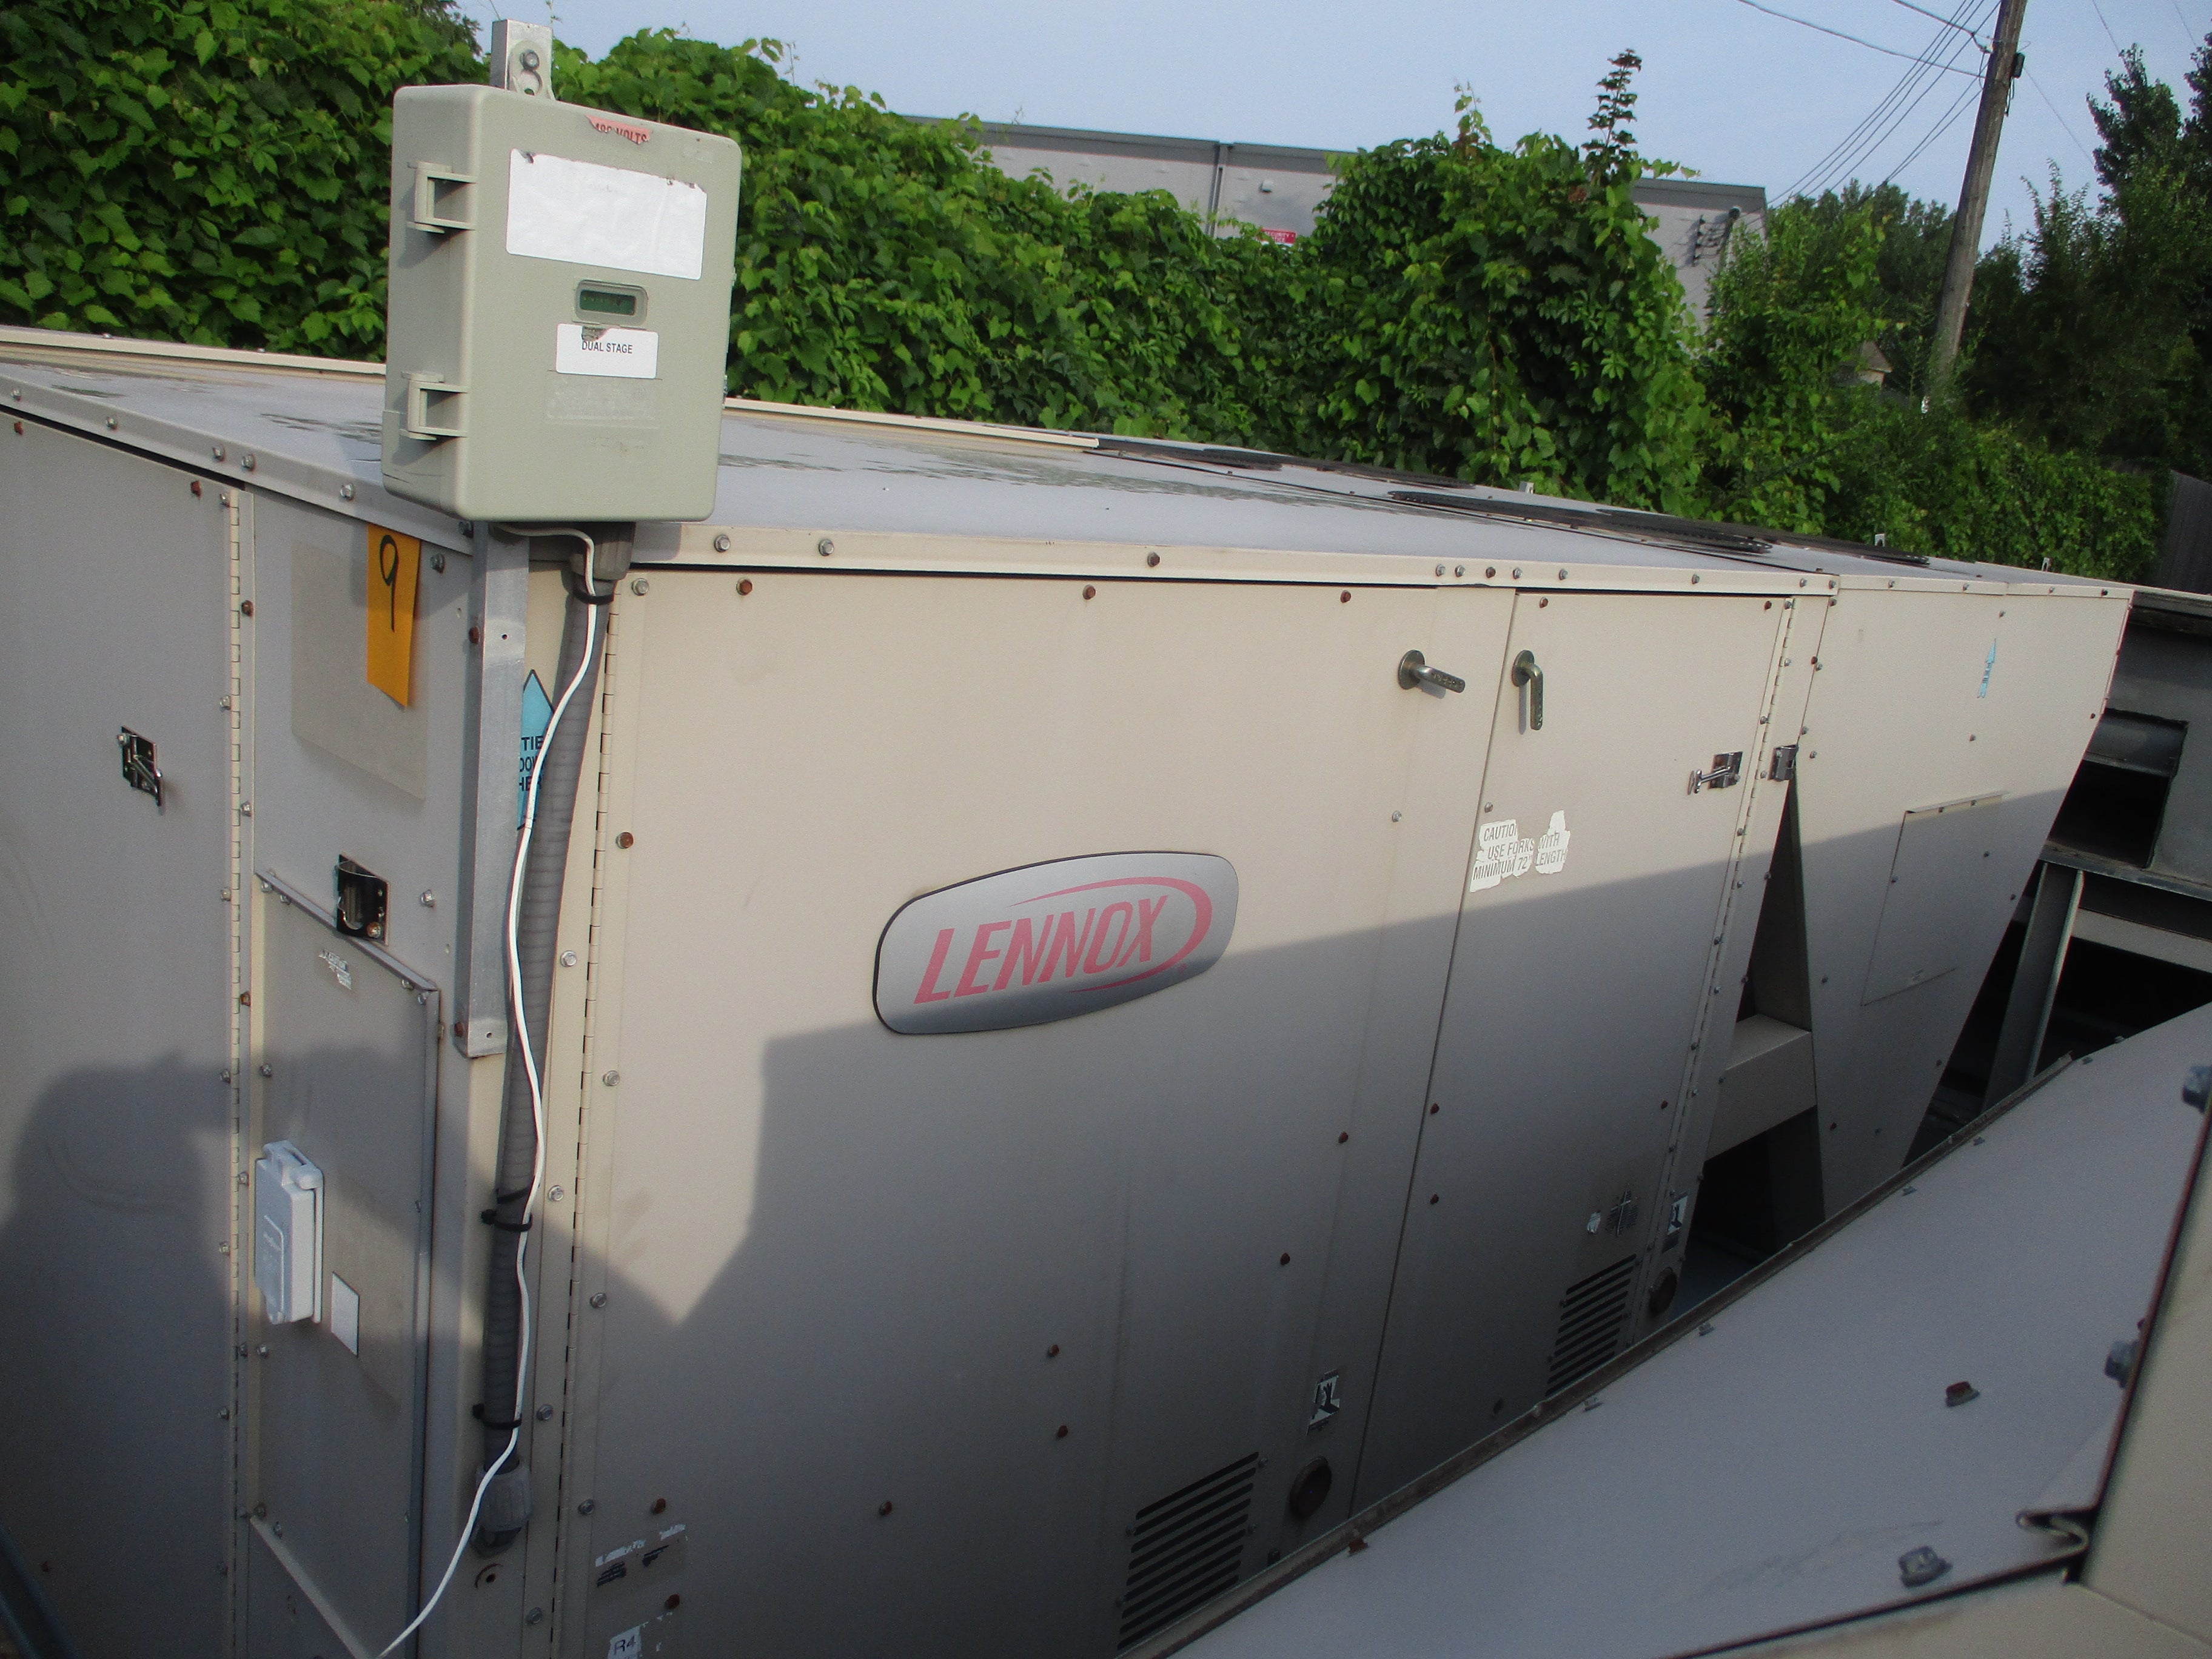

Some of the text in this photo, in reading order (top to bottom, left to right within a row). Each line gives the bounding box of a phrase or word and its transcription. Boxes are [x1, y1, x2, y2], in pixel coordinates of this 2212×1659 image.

[582, 341, 633, 354] DUAL STAGE
[380, 535, 399, 632] 9
[521, 736, 544, 751] TIE
[1487, 844, 1505, 859] USE
[1507, 838, 1534, 856] FORKS
[1473, 858, 1516, 880] MINIMUM
[1535, 850, 1567, 866] LENGTH
[913, 895, 1168, 1004] LENNOX
